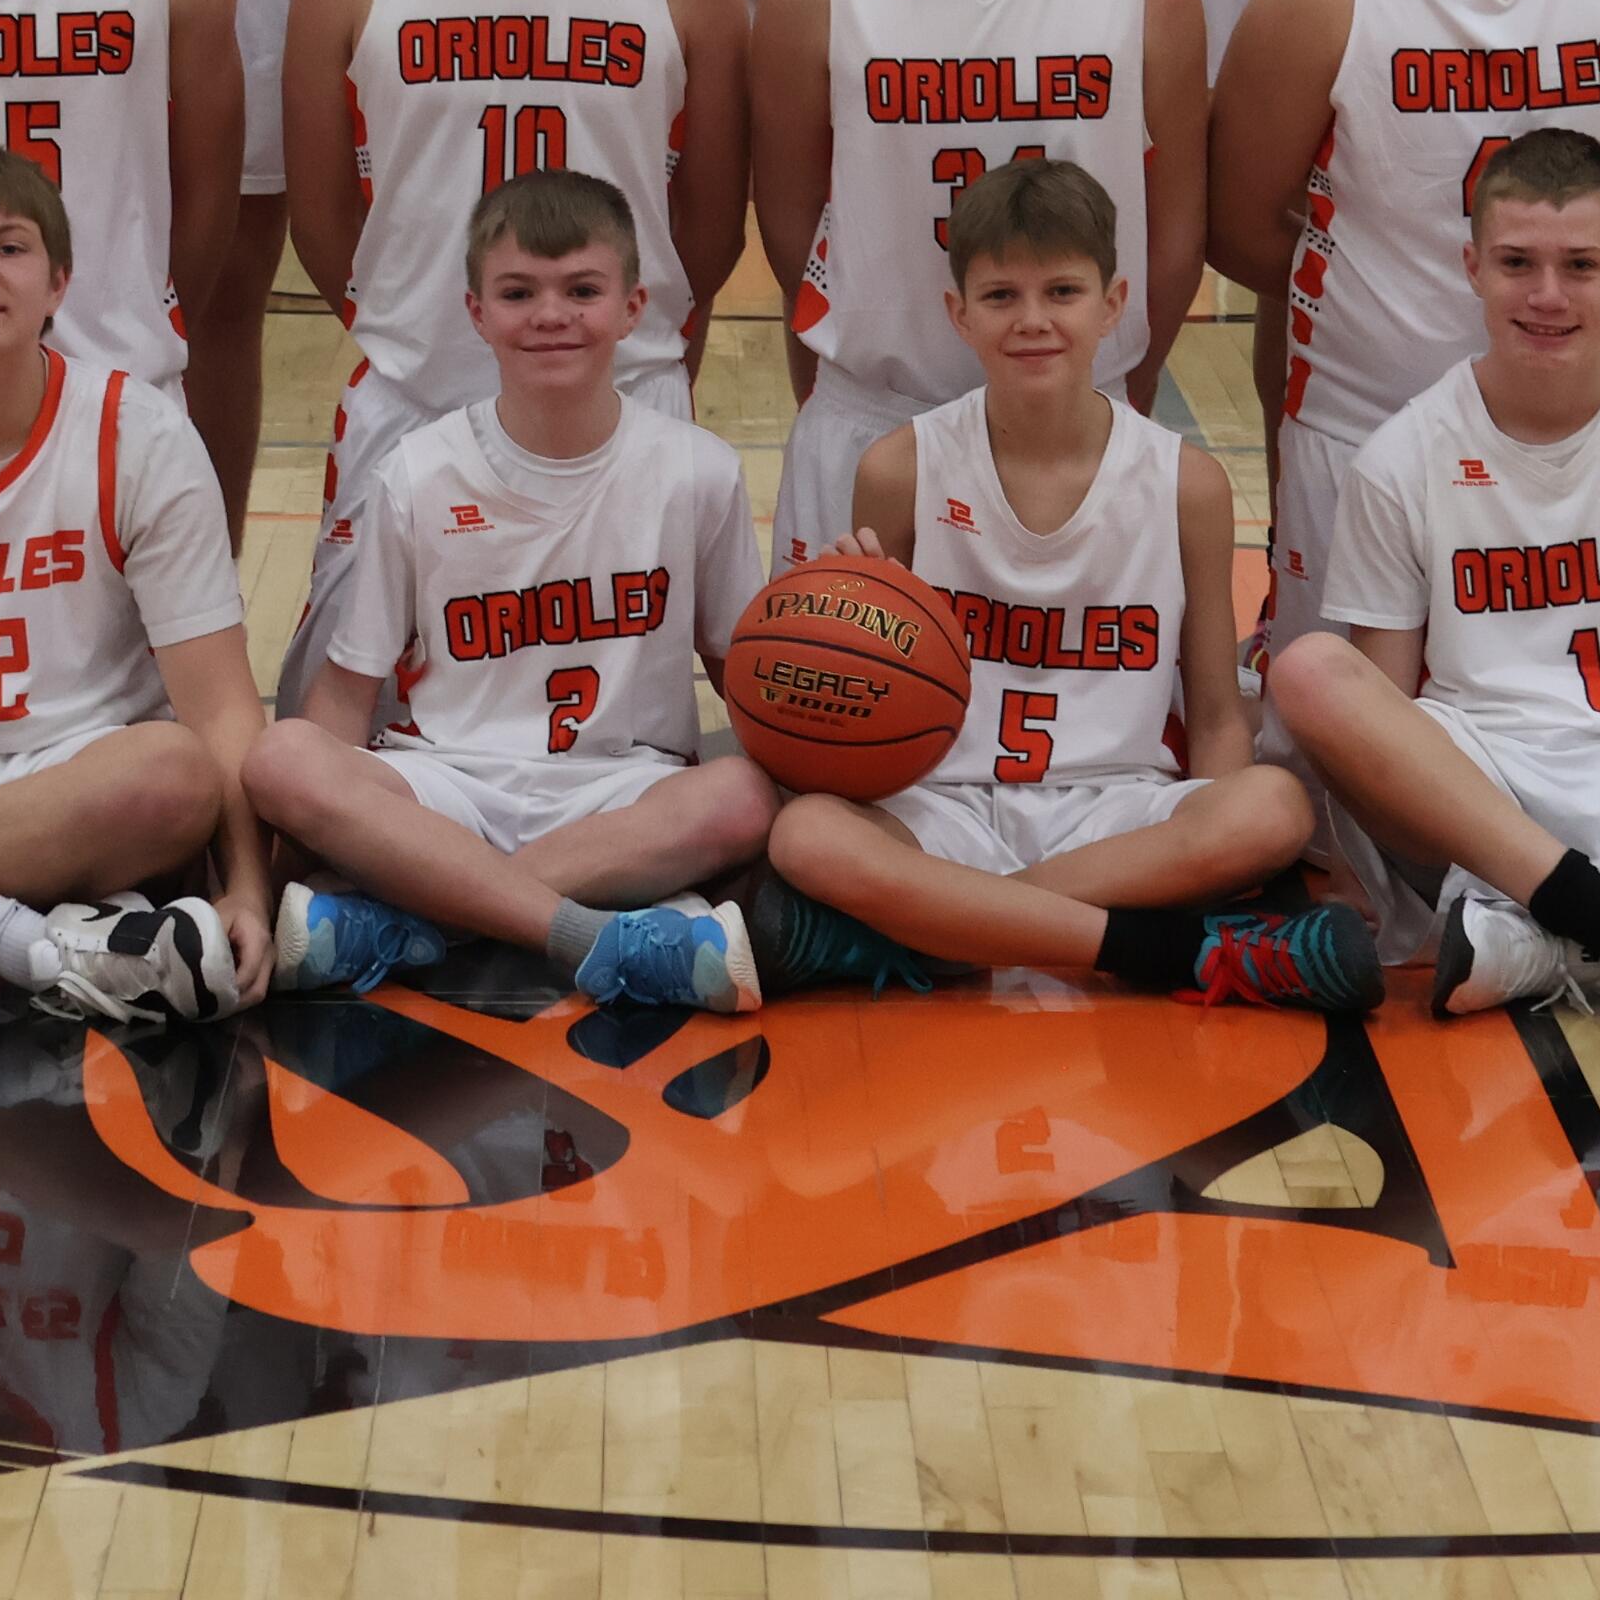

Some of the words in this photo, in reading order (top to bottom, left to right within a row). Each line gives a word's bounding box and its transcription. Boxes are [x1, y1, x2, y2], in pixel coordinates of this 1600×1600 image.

[398, 15, 646, 87] ORIOLES
[865, 54, 1112, 123] ORIOLES
[758, 592, 921, 658] SPALDING
[546, 665, 600, 754] 2
[753, 657, 890, 703] LEGACY
[994, 689, 1058, 784] 5
